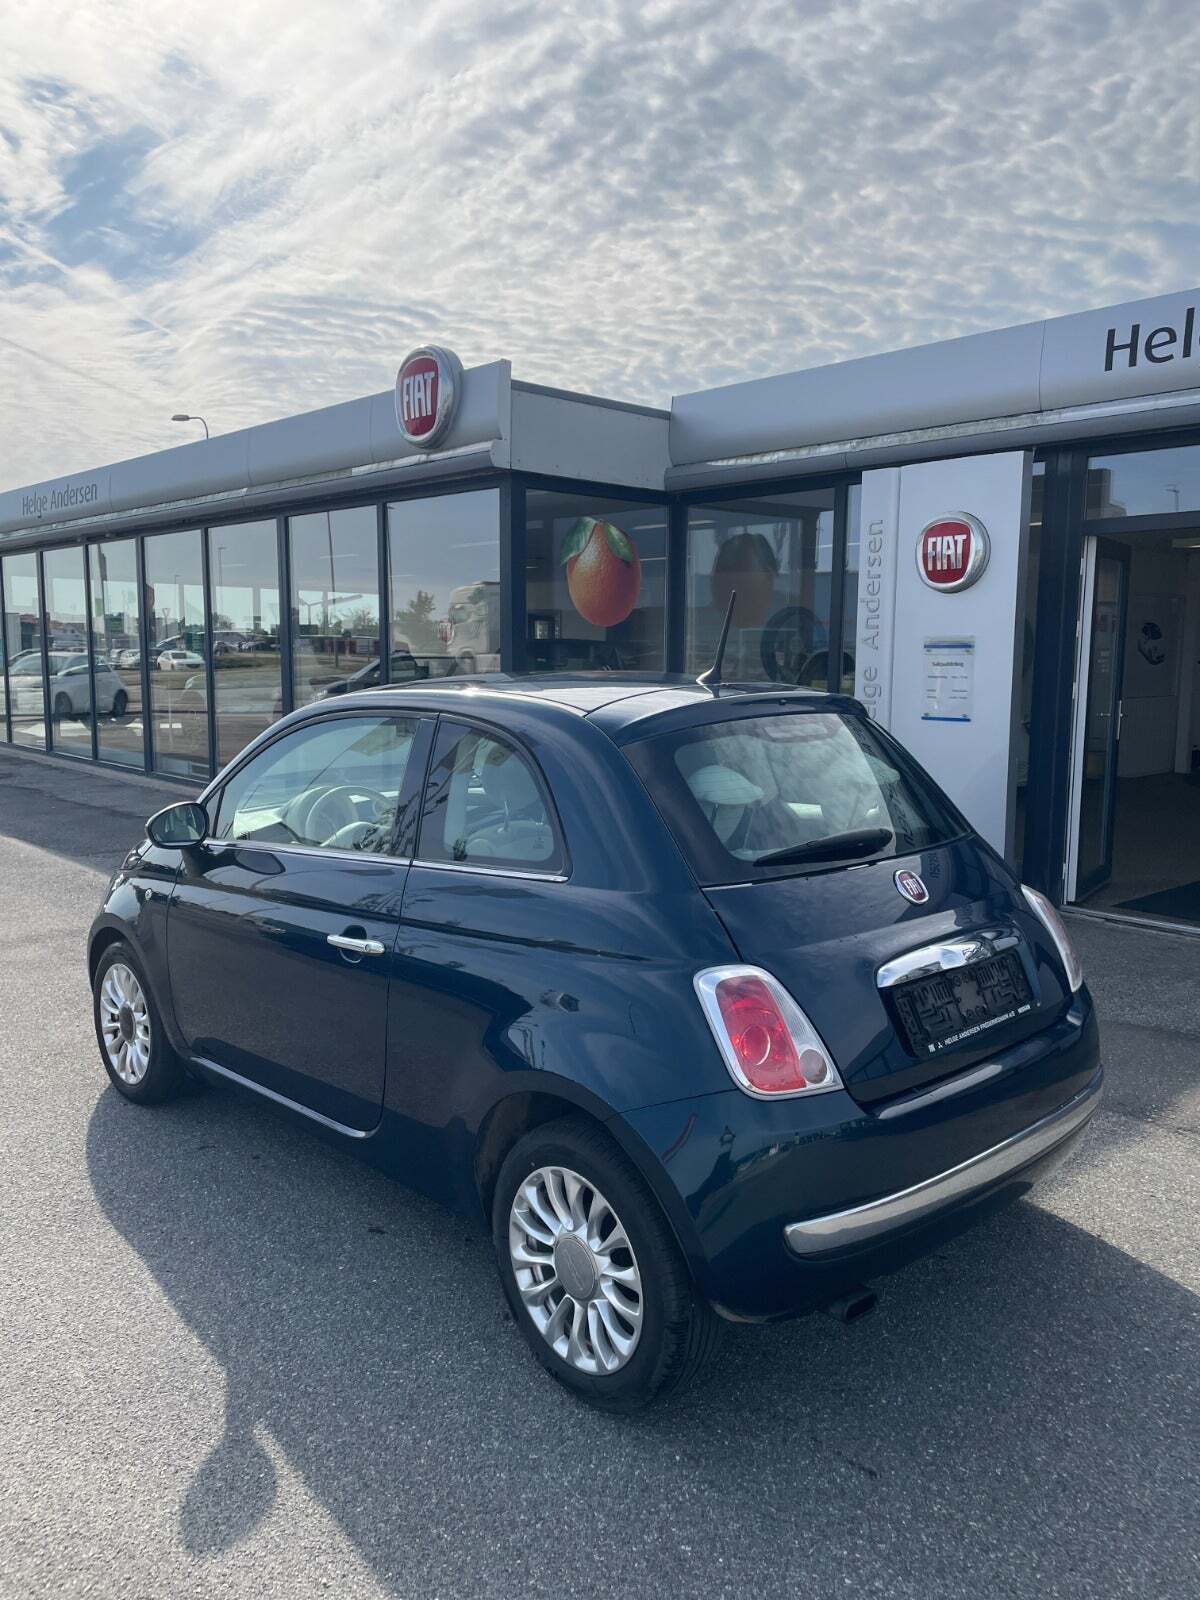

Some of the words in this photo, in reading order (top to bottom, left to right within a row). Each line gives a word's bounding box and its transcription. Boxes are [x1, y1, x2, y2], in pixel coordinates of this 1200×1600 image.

[1104, 307, 1200, 372] Hel
[403, 371, 435, 421] FIAT
[22, 490, 48, 519] Helge
[50, 483, 98, 510] Andersen
[928, 534, 967, 571] FIAT
[861, 519, 883, 651] Andersen
[864, 667, 882, 719] elge
[903, 878, 923, 896] FIAT
